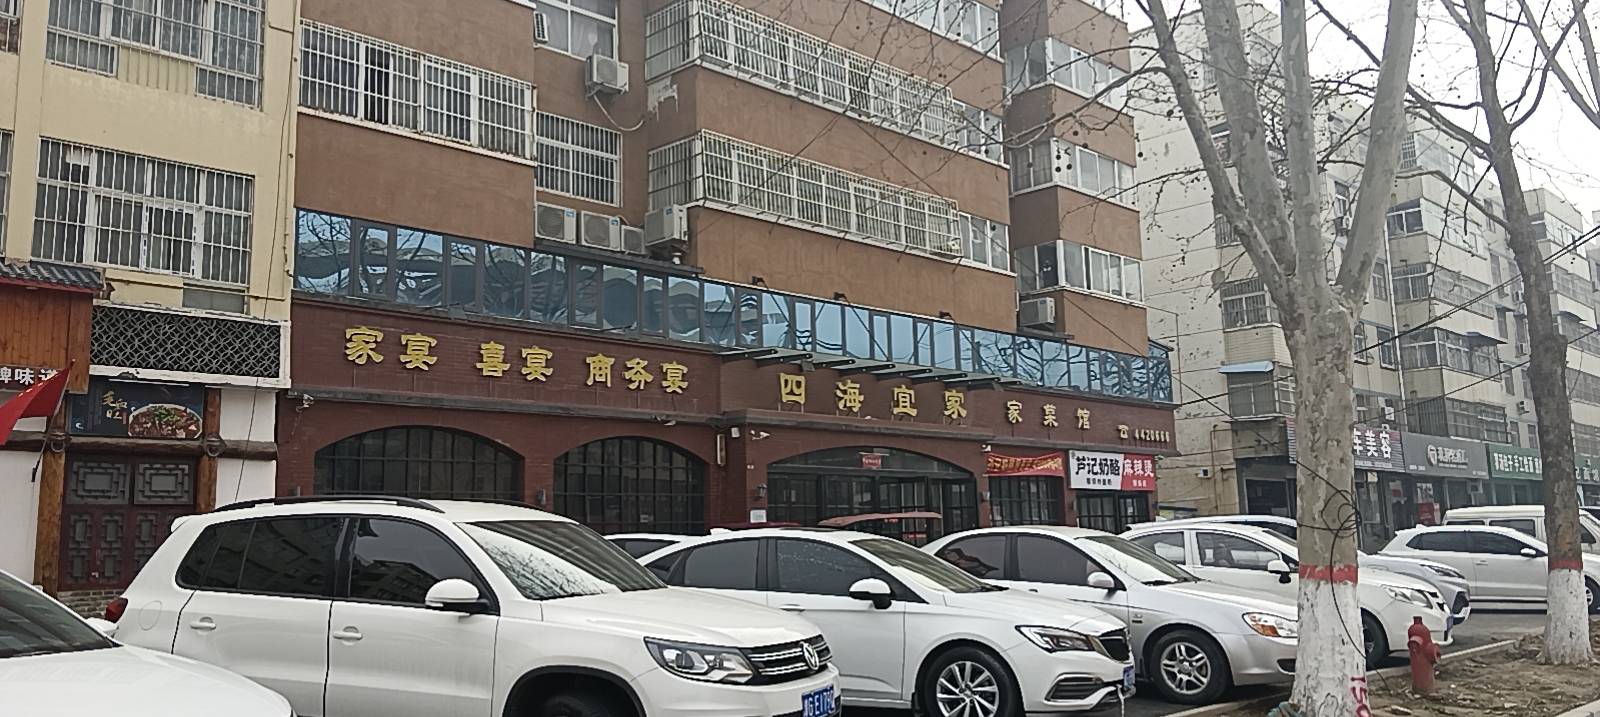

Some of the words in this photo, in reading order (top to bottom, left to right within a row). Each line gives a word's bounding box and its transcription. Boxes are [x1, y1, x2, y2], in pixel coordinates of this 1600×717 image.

[345, 326, 437, 369] 家宴
[477, 341, 553, 381] 喜宴
[586, 353, 688, 394] 商务宴
[780, 373, 967, 419] 四海宜家
[1007, 400, 1090, 430] 家菜馆
[1075, 455, 1121, 476] 芦记奶酪
